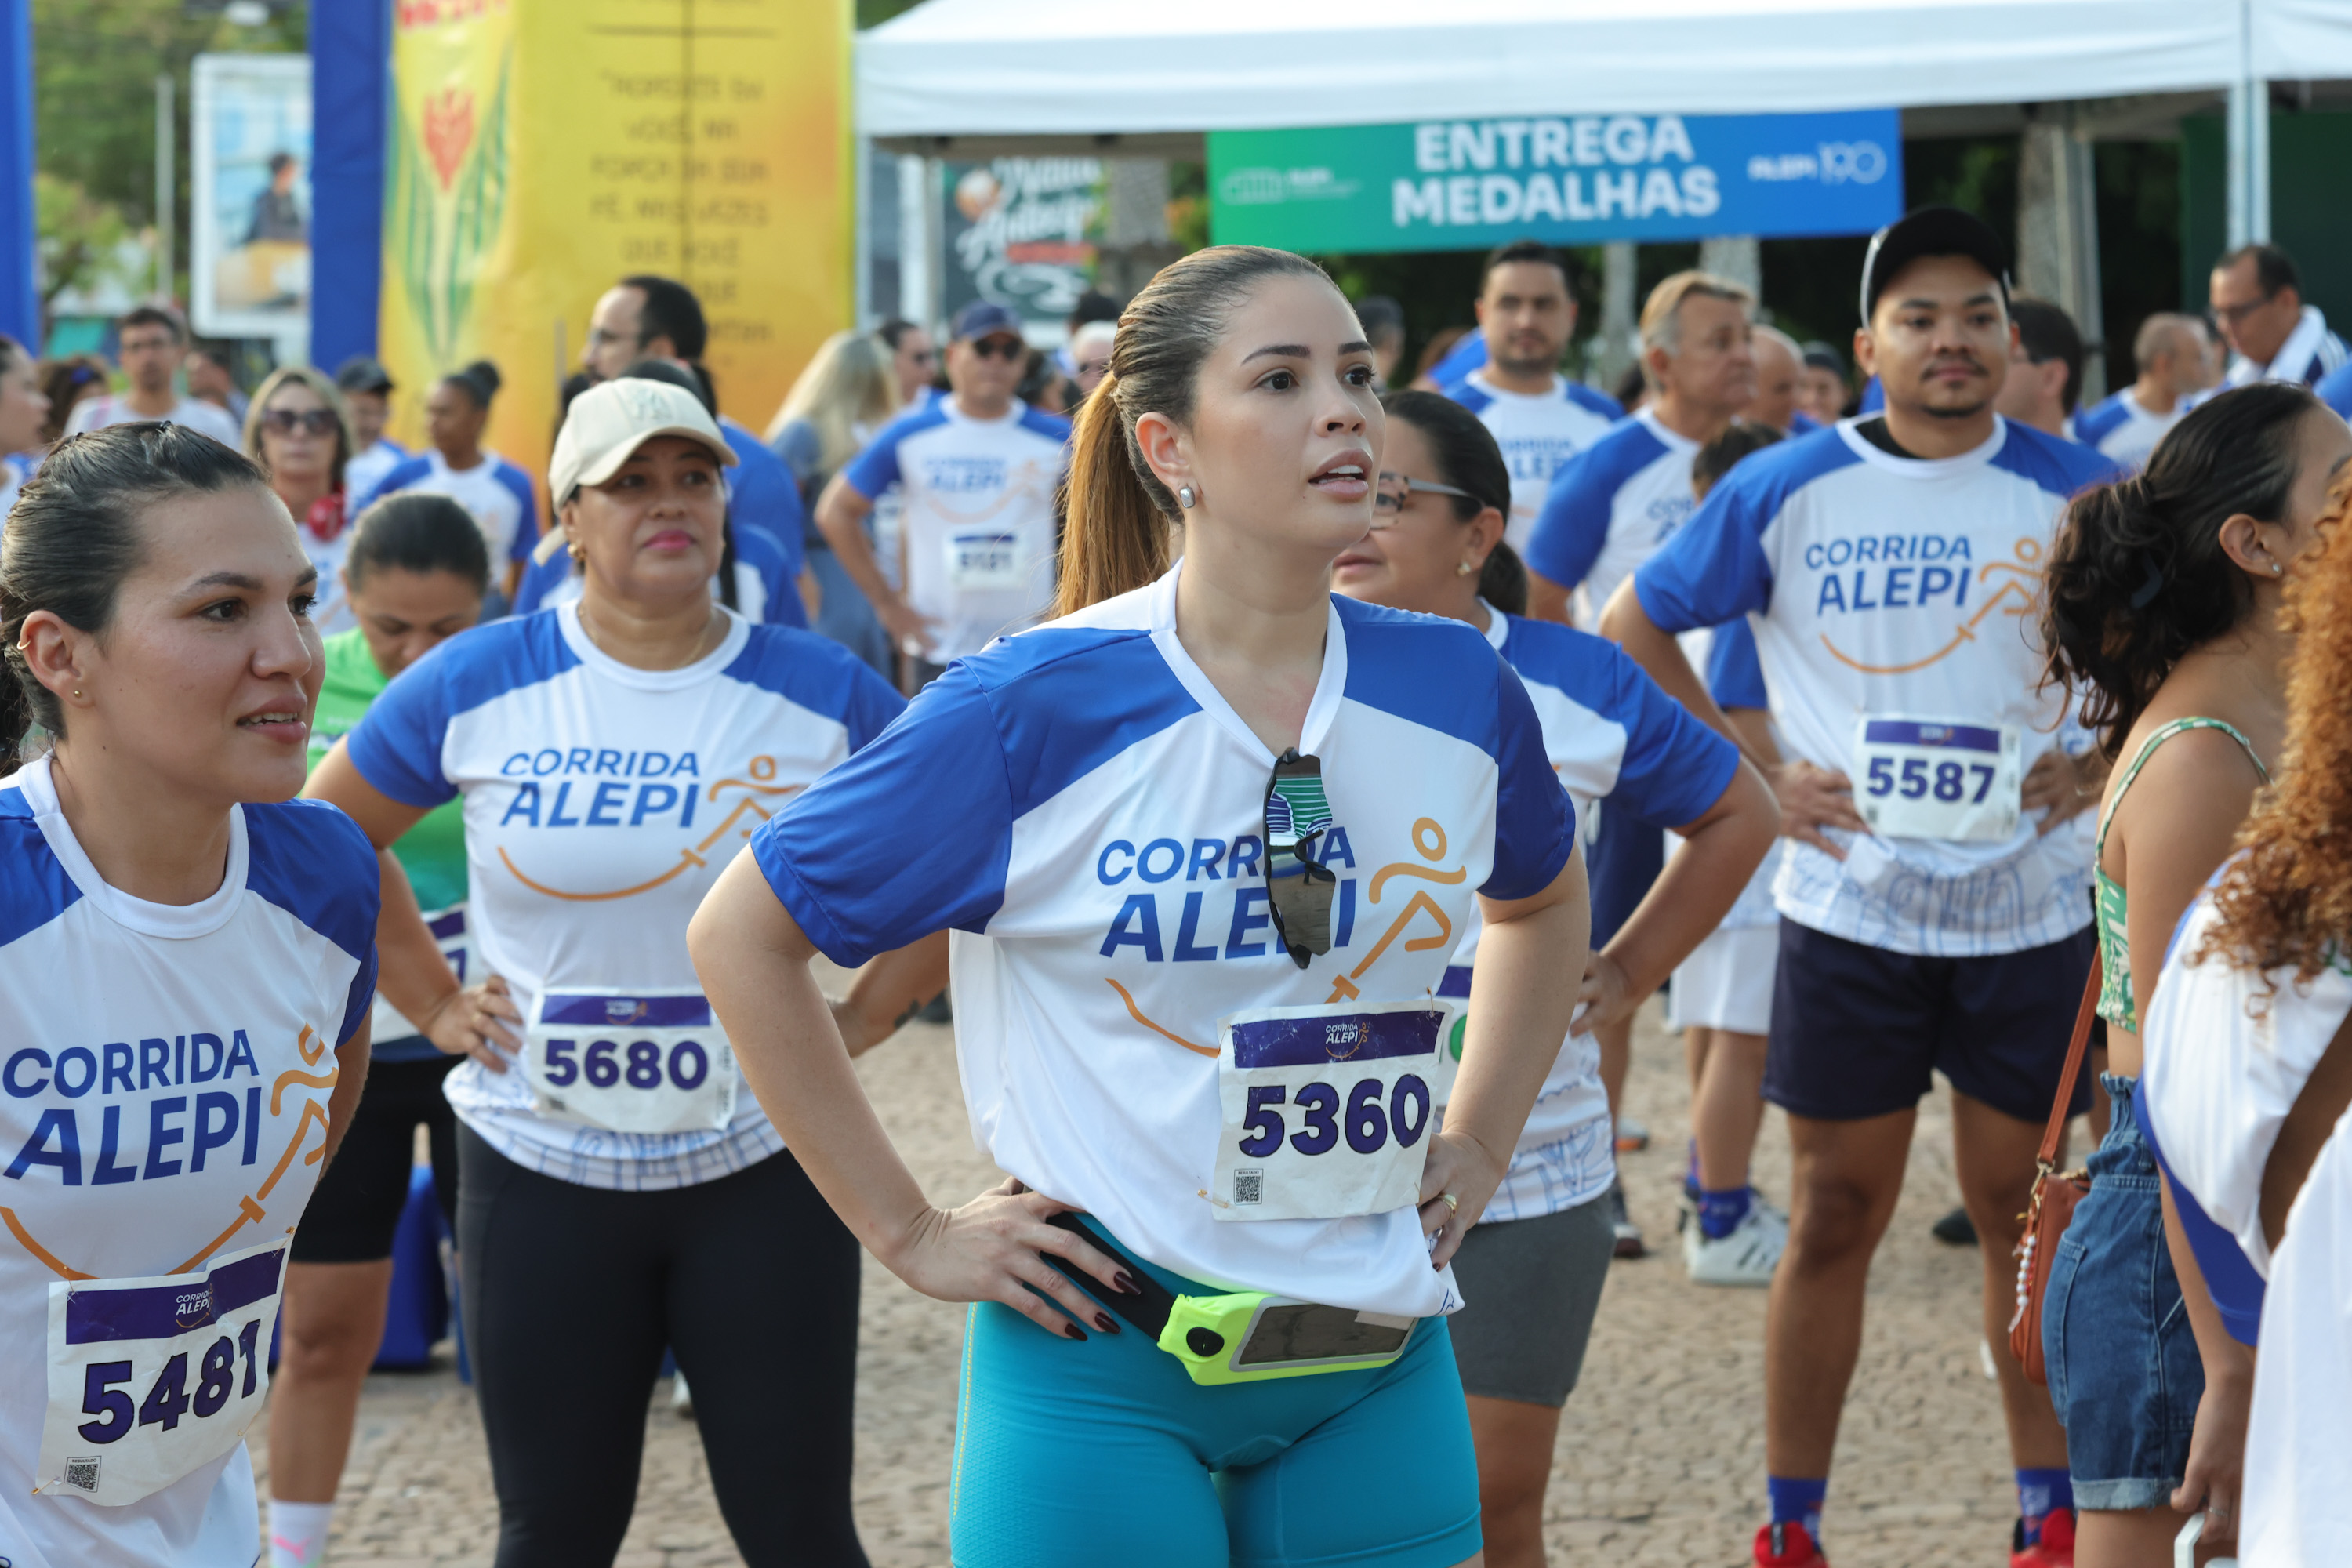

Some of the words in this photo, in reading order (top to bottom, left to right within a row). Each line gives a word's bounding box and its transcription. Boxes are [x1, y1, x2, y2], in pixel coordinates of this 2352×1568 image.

[1415, 114, 1695, 172] ENTREGA
[1391, 165, 1722, 227] MEDALHAS
[1806, 535, 1972, 570] CORRIDA
[1816, 567, 1971, 616] ALEPI
[499, 747, 700, 778] CORRIDA
[1867, 757, 1994, 804] 5587
[499, 782, 700, 828] ALEPI
[1097, 826, 1356, 886] CORRA
[1099, 878, 1357, 963] ALEI
[1325, 1023, 1359, 1033] CORRIDA
[1325, 1030, 1359, 1044] ALEPI
[2, 1029, 260, 1098] CORRIDA
[544, 1040, 709, 1090] 5680
[2, 1087, 262, 1186] ALEPI
[1238, 1073, 1431, 1158] 5360
[175, 1297, 210, 1316] ALEPI
[77, 1319, 261, 1444] 5481
